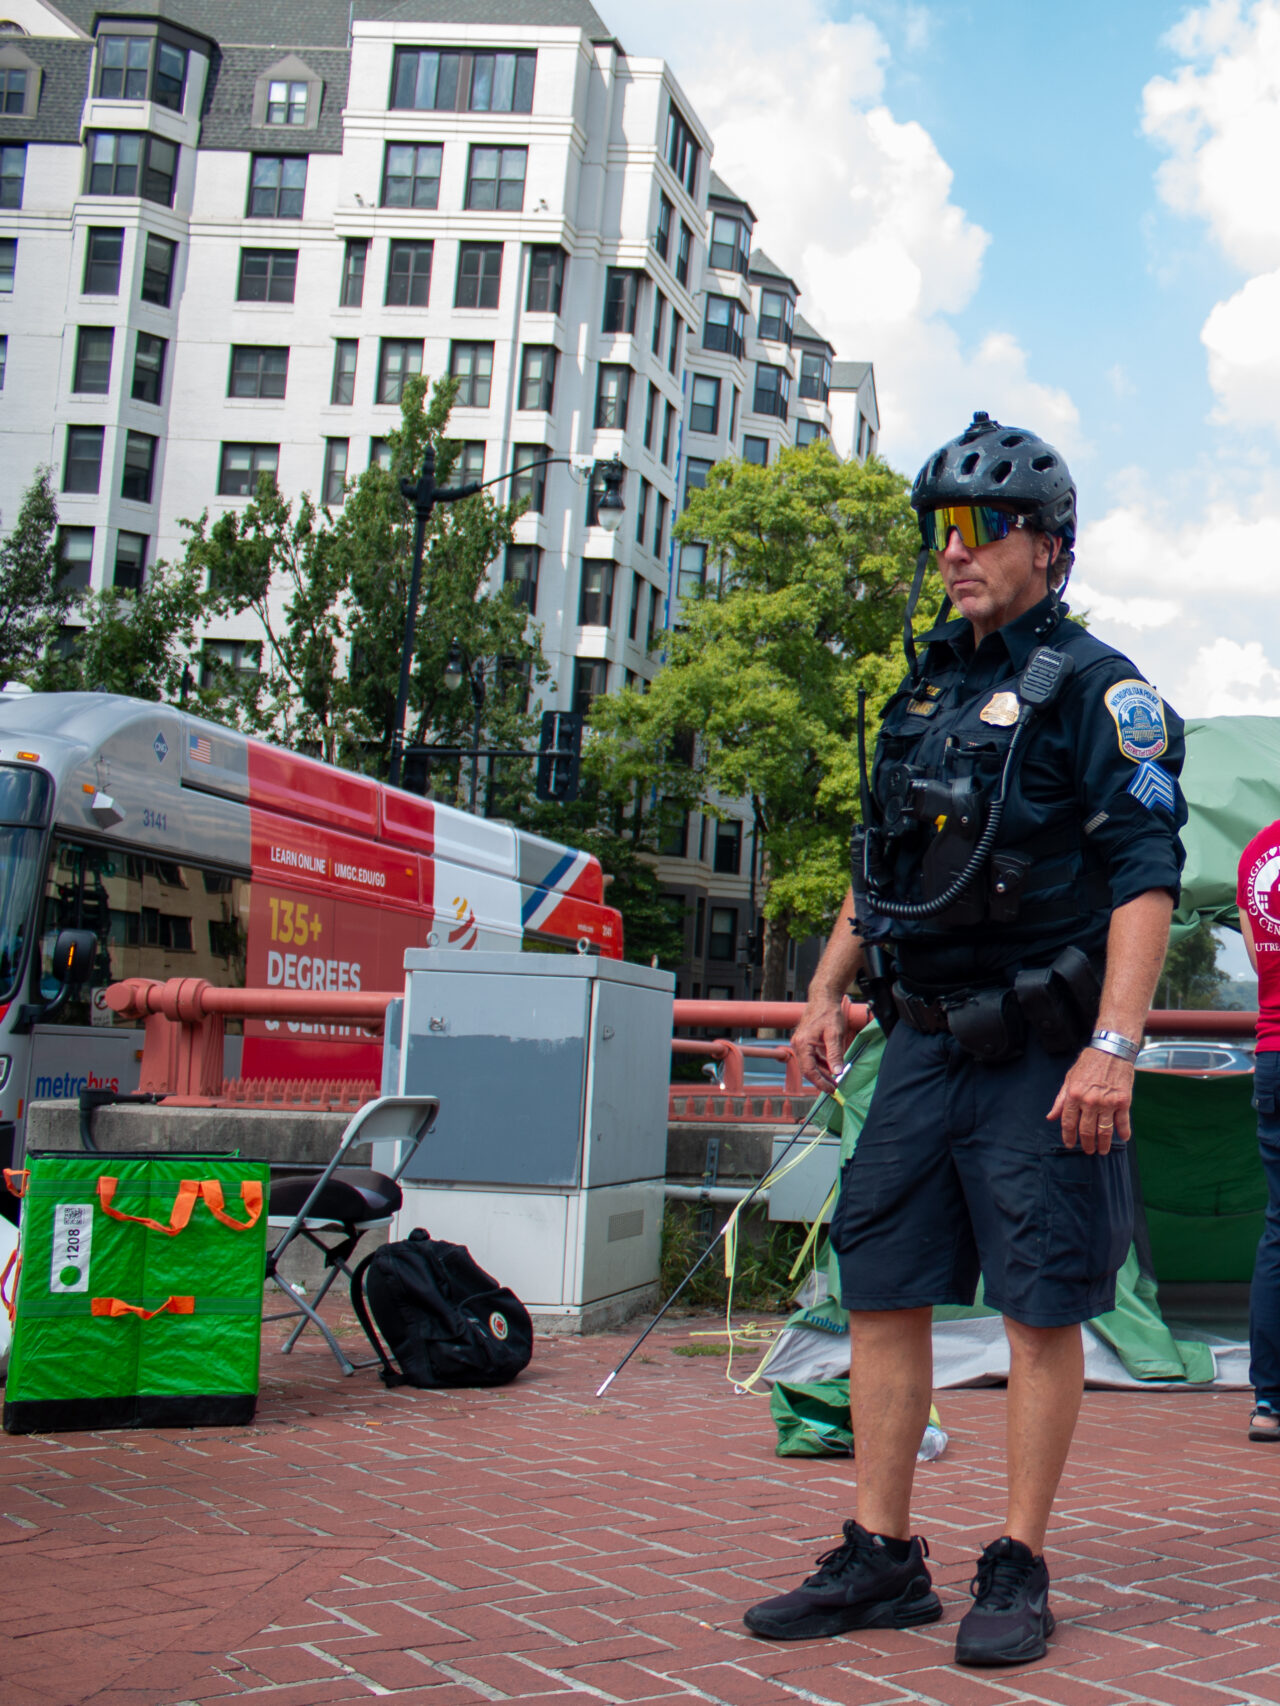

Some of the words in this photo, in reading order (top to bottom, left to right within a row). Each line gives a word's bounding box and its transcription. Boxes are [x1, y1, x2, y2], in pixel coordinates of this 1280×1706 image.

[1110, 687, 1143, 707] METROPOLITAN
[1143, 689, 1160, 705] POLICE
[154, 742, 169, 753] CNG
[143, 808, 167, 831] 3141
[270, 845, 298, 867] LEARN
[298, 853, 327, 875] ONLINE
[334, 862, 386, 888] UMGC.EDU/GO
[269, 897, 323, 946] 135+
[267, 950, 361, 992] DEGREES
[66, 1229, 80, 1261] 1208
